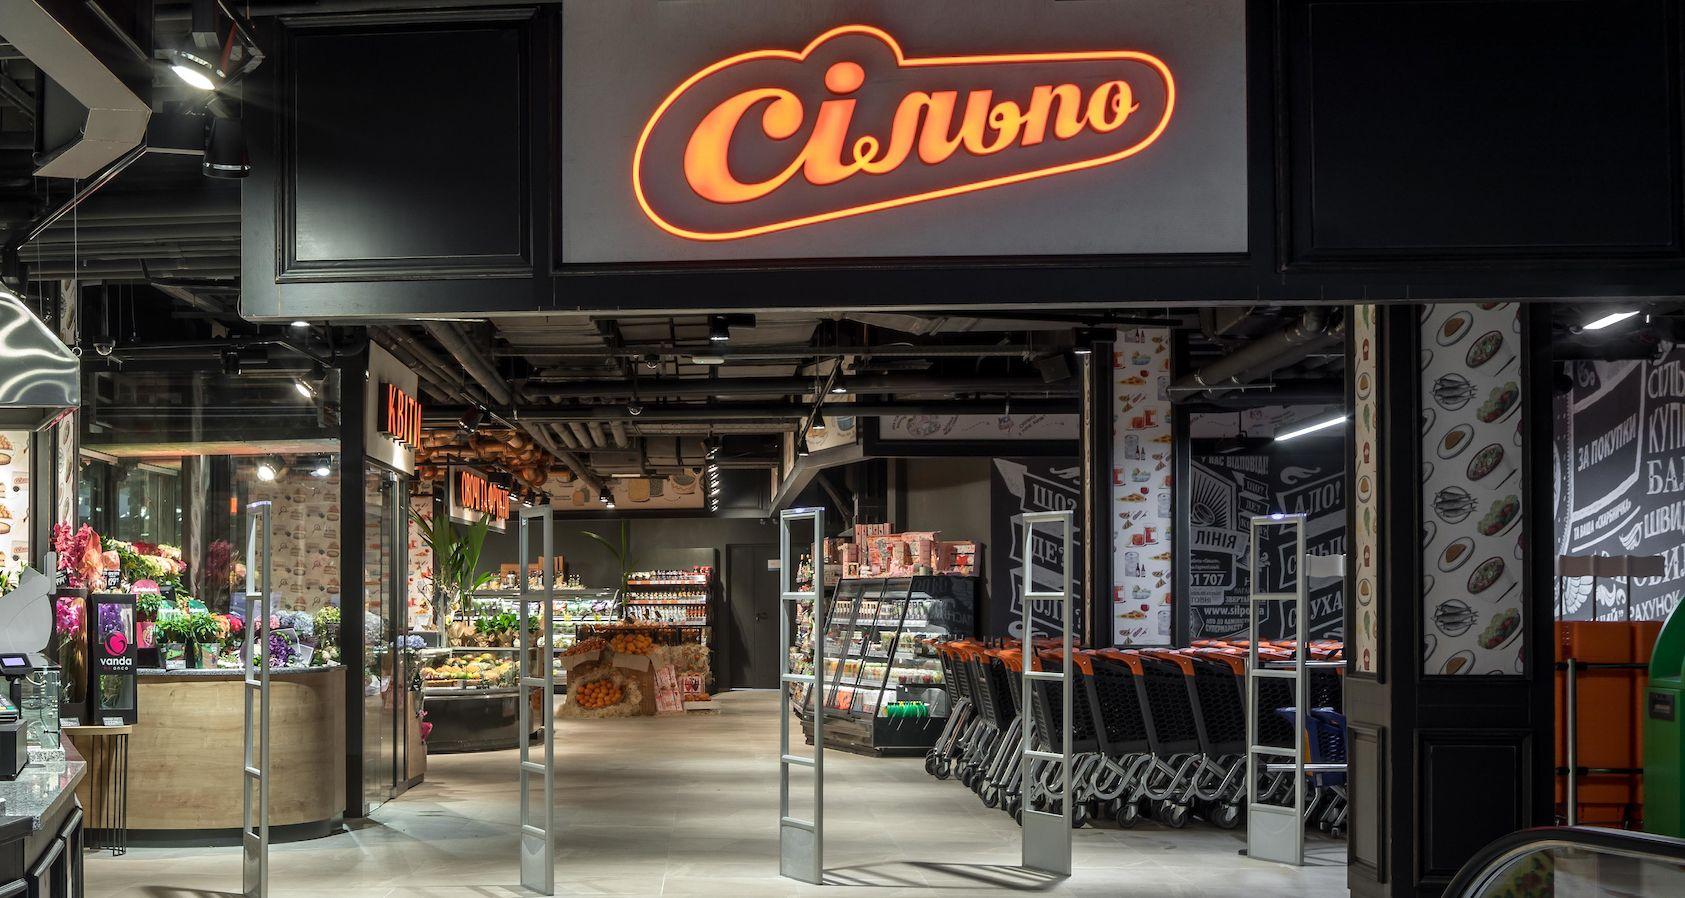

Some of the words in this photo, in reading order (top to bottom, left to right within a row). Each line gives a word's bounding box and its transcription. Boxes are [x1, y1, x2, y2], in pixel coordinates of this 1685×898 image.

[684, 61, 1140, 204] Сільпо
[387, 383, 422, 450] КВІТИ
[1578, 444, 1590, 472] ЗА
[1591, 412, 1637, 466] ПОКУПКИ
[1294, 480, 1341, 517] АЛО!
[1195, 530, 1237, 550] ЛІНІЯ
[1203, 573, 1225, 586] 707
[100, 656, 132, 666] vanda
